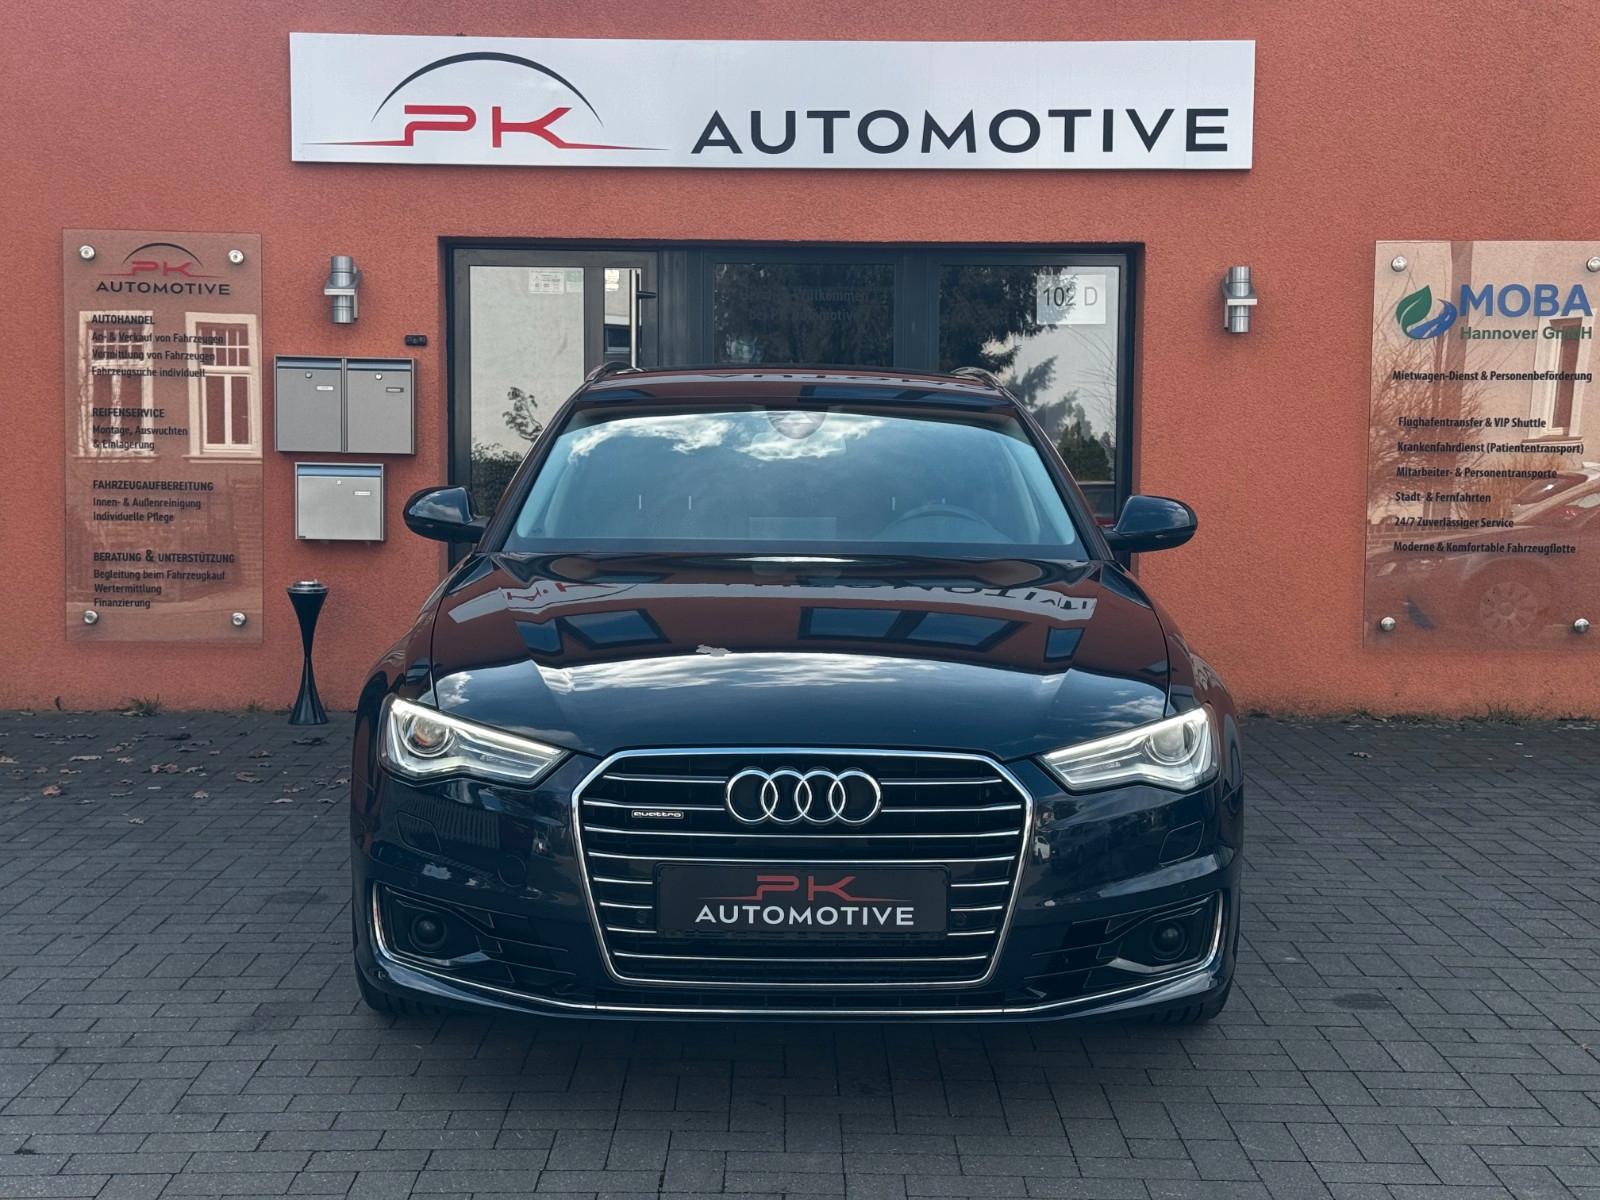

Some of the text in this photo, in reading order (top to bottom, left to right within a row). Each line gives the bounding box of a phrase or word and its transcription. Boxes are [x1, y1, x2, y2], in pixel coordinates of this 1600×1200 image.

[404, 105, 572, 149] PK
[690, 108, 1228, 155] AUTOMOTIVE
[131, 261, 193, 277] PK
[96, 281, 231, 295] AUTOMOTIVE
[1043, 286, 1098, 307] 102 D
[1459, 284, 1593, 317] MOBA
[91, 315, 155, 325] AUTOHANDEL
[119, 332, 153, 342] Verkauf
[173, 333, 224, 345] Fahrzeugen
[1460, 326, 1538, 340] Hannover
[147, 352, 163, 360] von
[165, 350, 215, 362] Fahrzeugen
[92, 366, 206, 378] Fahrzeugsuche individuell
[1392, 370, 1593, 383] Mietwagen-Dienst & Personenbeförderung
[92, 408, 165, 418] REIFENSERVICE
[1398, 416, 1546, 429] Flughafentransfer & VIP Shuttle
[92, 426, 188, 437] Montage, Auswuchten
[93, 440, 155, 451] & Einlagerung
[1397, 442, 1585, 455] Krankenfahrdienst (Patiententransport)
[1396, 466, 1558, 480] Mitarbeiter- & Personentransporte
[93, 480, 214, 491] FAHRZEUGAUFBEREITUNG
[93, 498, 202, 510] Innen- & Außenreinigung
[1395, 492, 1492, 503] Stadt- & Fernfahrten
[93, 512, 175, 524] Individuelle Pflege
[1394, 517, 1514, 529] 24/7 Zuverlässiger Service
[1393, 542, 1577, 556] Moderne & Komfortable Fahrzeugflotte
[93, 550, 236, 564] BERATUNG & UNTERSTÜTZUNG
[94, 569, 225, 582] Begleitung beim Fahrzeugkauf
[94, 584, 162, 595] Wertermittlung
[94, 598, 151, 609] Finanzierung
[756, 875, 856, 901] PK
[695, 905, 914, 926] AUTOMOTIVE
